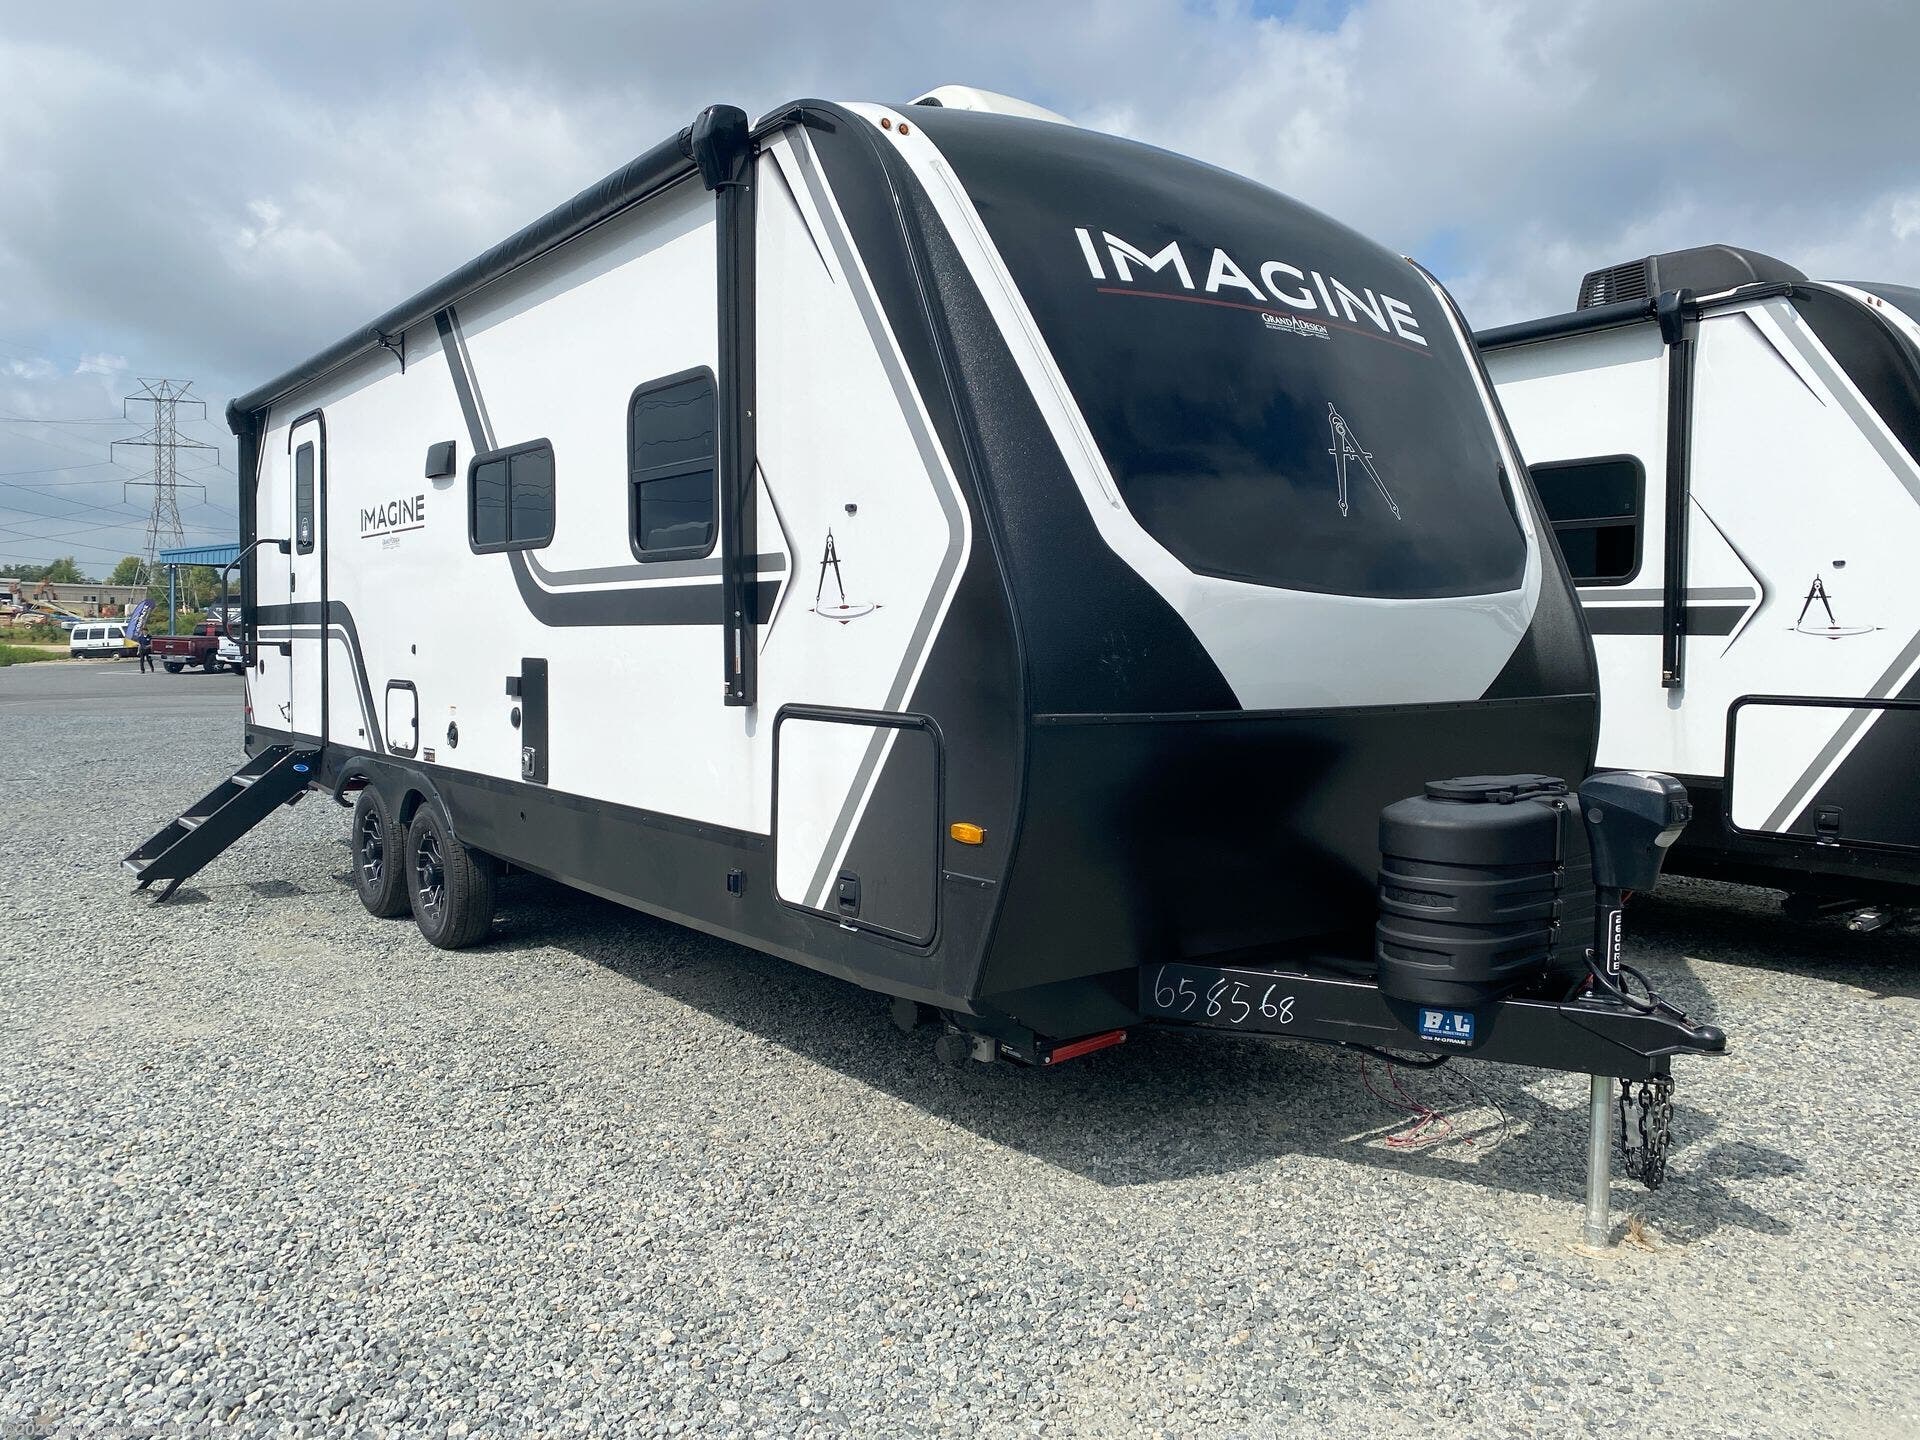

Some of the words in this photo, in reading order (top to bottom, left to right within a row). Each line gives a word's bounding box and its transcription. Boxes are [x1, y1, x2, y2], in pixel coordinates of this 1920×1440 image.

[1074, 228, 1428, 346] IMAGINE
[1261, 312, 1293, 326] GRAND
[1300, 319, 1328, 334] DESIGN
[360, 494, 425, 532] IMAGINE
[1154, 964, 1296, 1024] 658568
